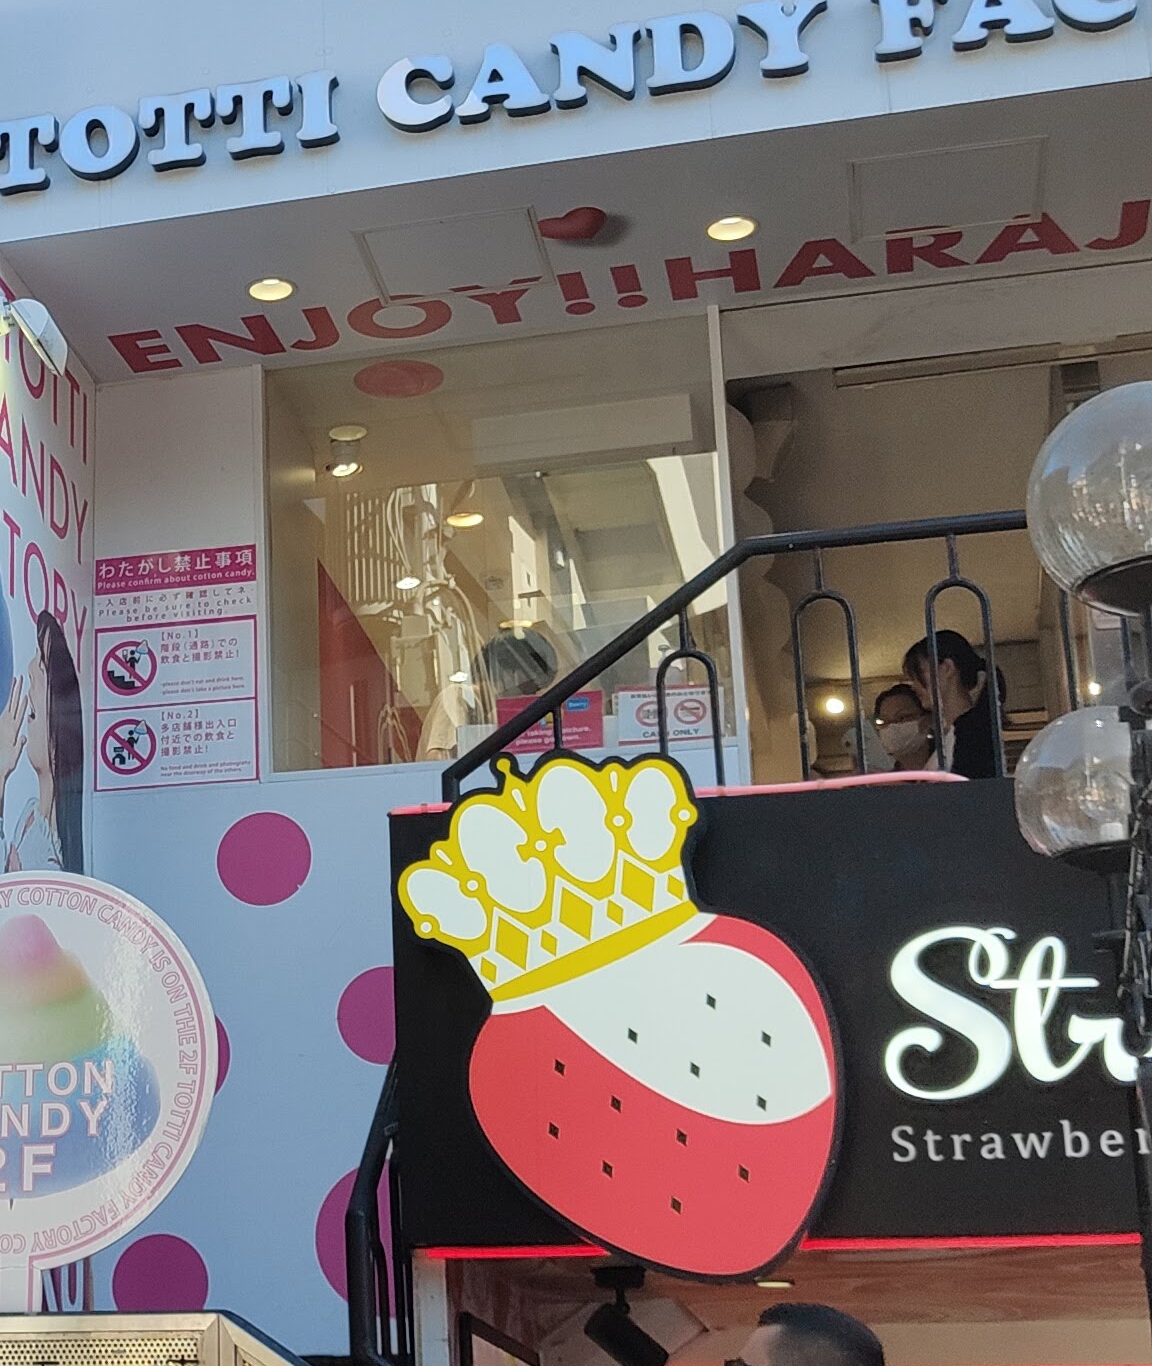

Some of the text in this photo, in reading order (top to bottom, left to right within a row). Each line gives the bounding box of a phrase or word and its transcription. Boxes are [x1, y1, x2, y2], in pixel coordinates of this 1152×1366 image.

[99, 549, 253, 579] わたがし禁止事項
[98, 568, 255, 589] Please confirm about cotton candy.
[99, 597, 252, 617] Please be sure to check
[126, 613, 166, 623] before
[17, 887, 98, 915] COTTON
[149, 948, 172, 974] IS
[161, 971, 188, 1004] ON
[173, 1002, 198, 1046] THE
[178, 1049, 198, 1076] 2F
[162, 1079, 197, 1142] TOTTI
[30, 1200, 120, 1254] FACTORY
